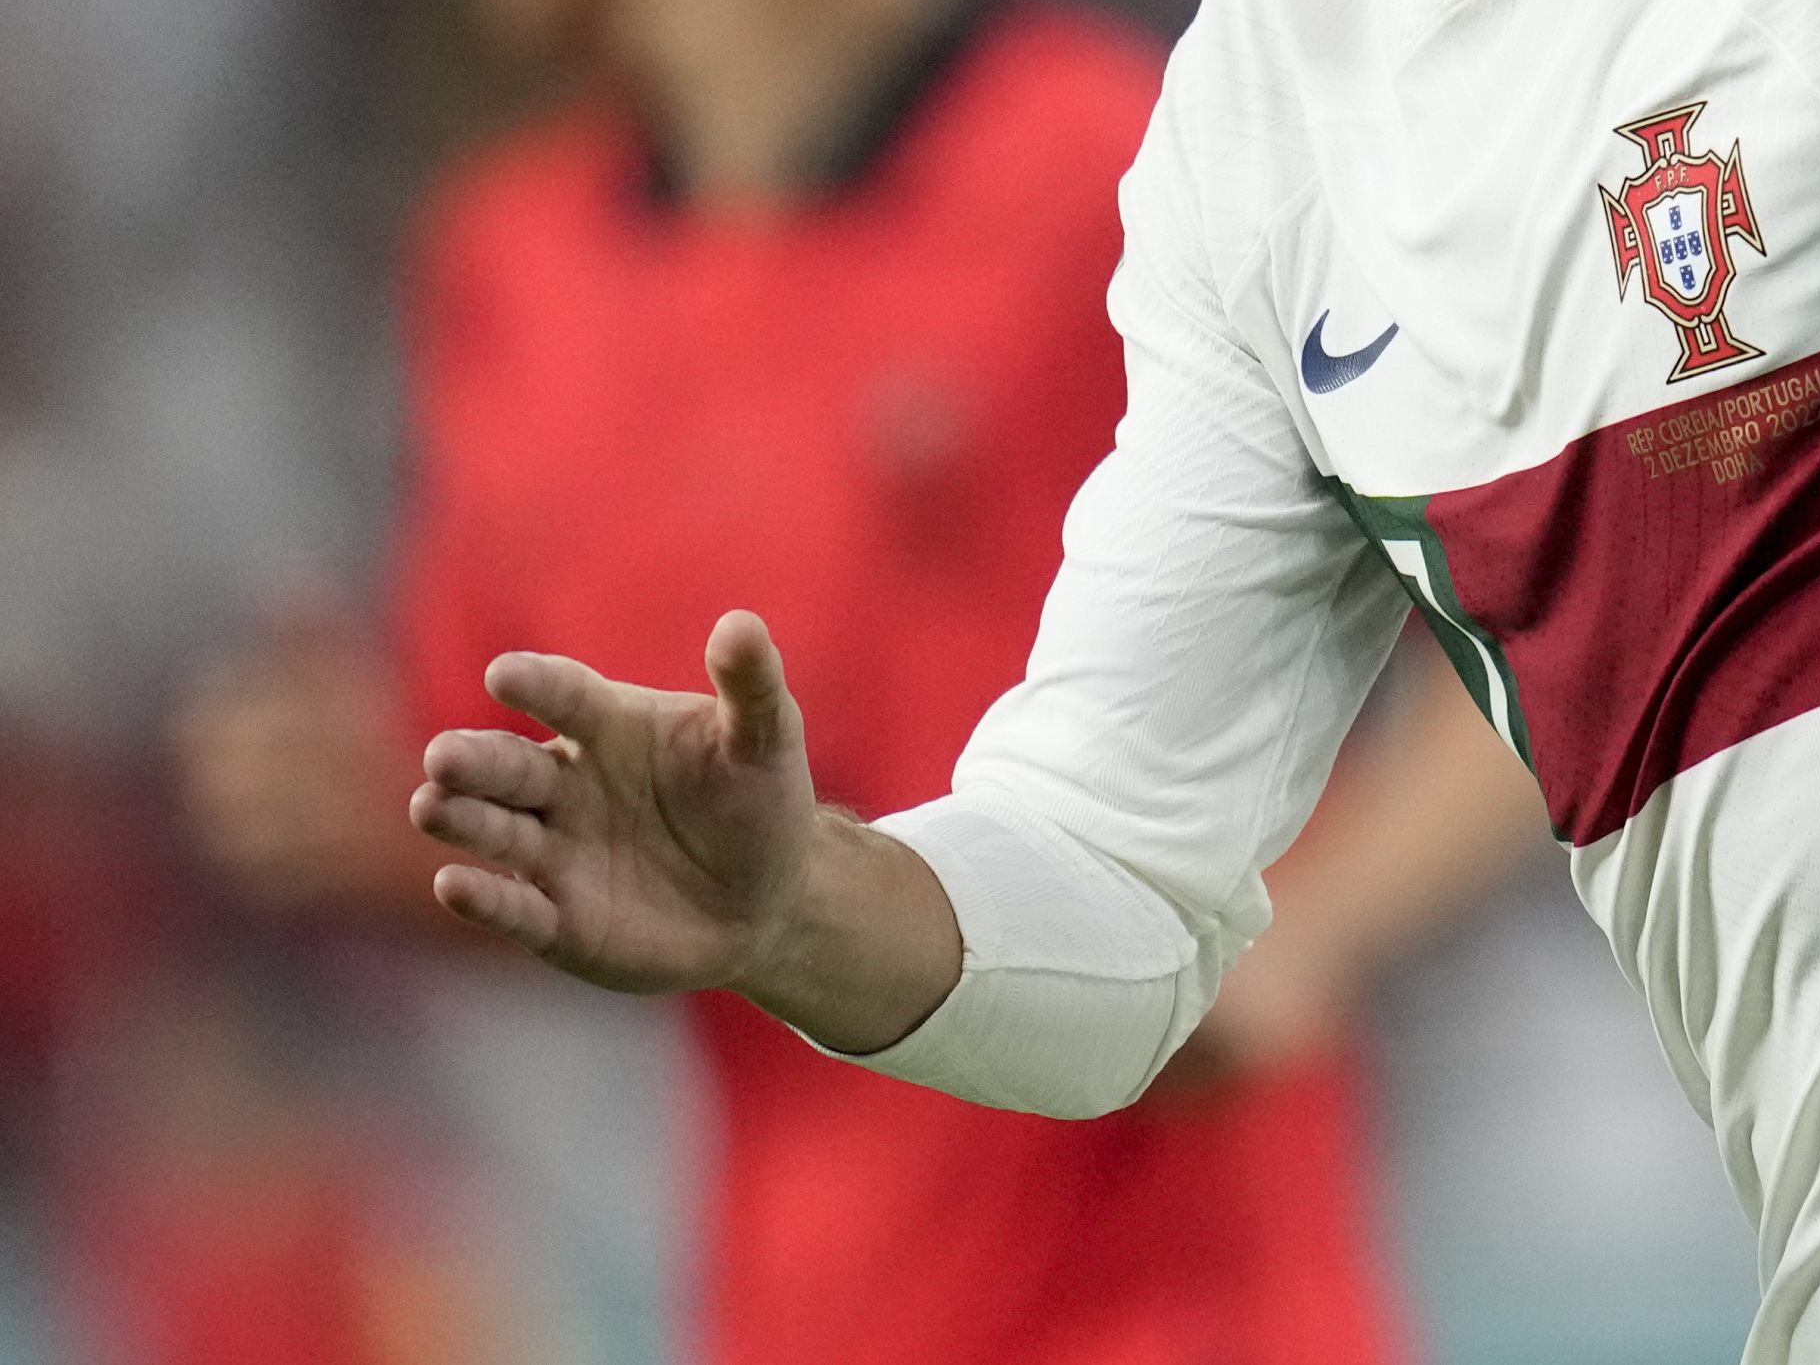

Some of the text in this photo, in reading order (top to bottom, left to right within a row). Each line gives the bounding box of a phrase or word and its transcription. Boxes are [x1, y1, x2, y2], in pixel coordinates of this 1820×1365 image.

[1643, 456, 1660, 480] 2
[1658, 421, 1762, 475] DEZEMBRO
[1710, 451, 1766, 484] DOHA
